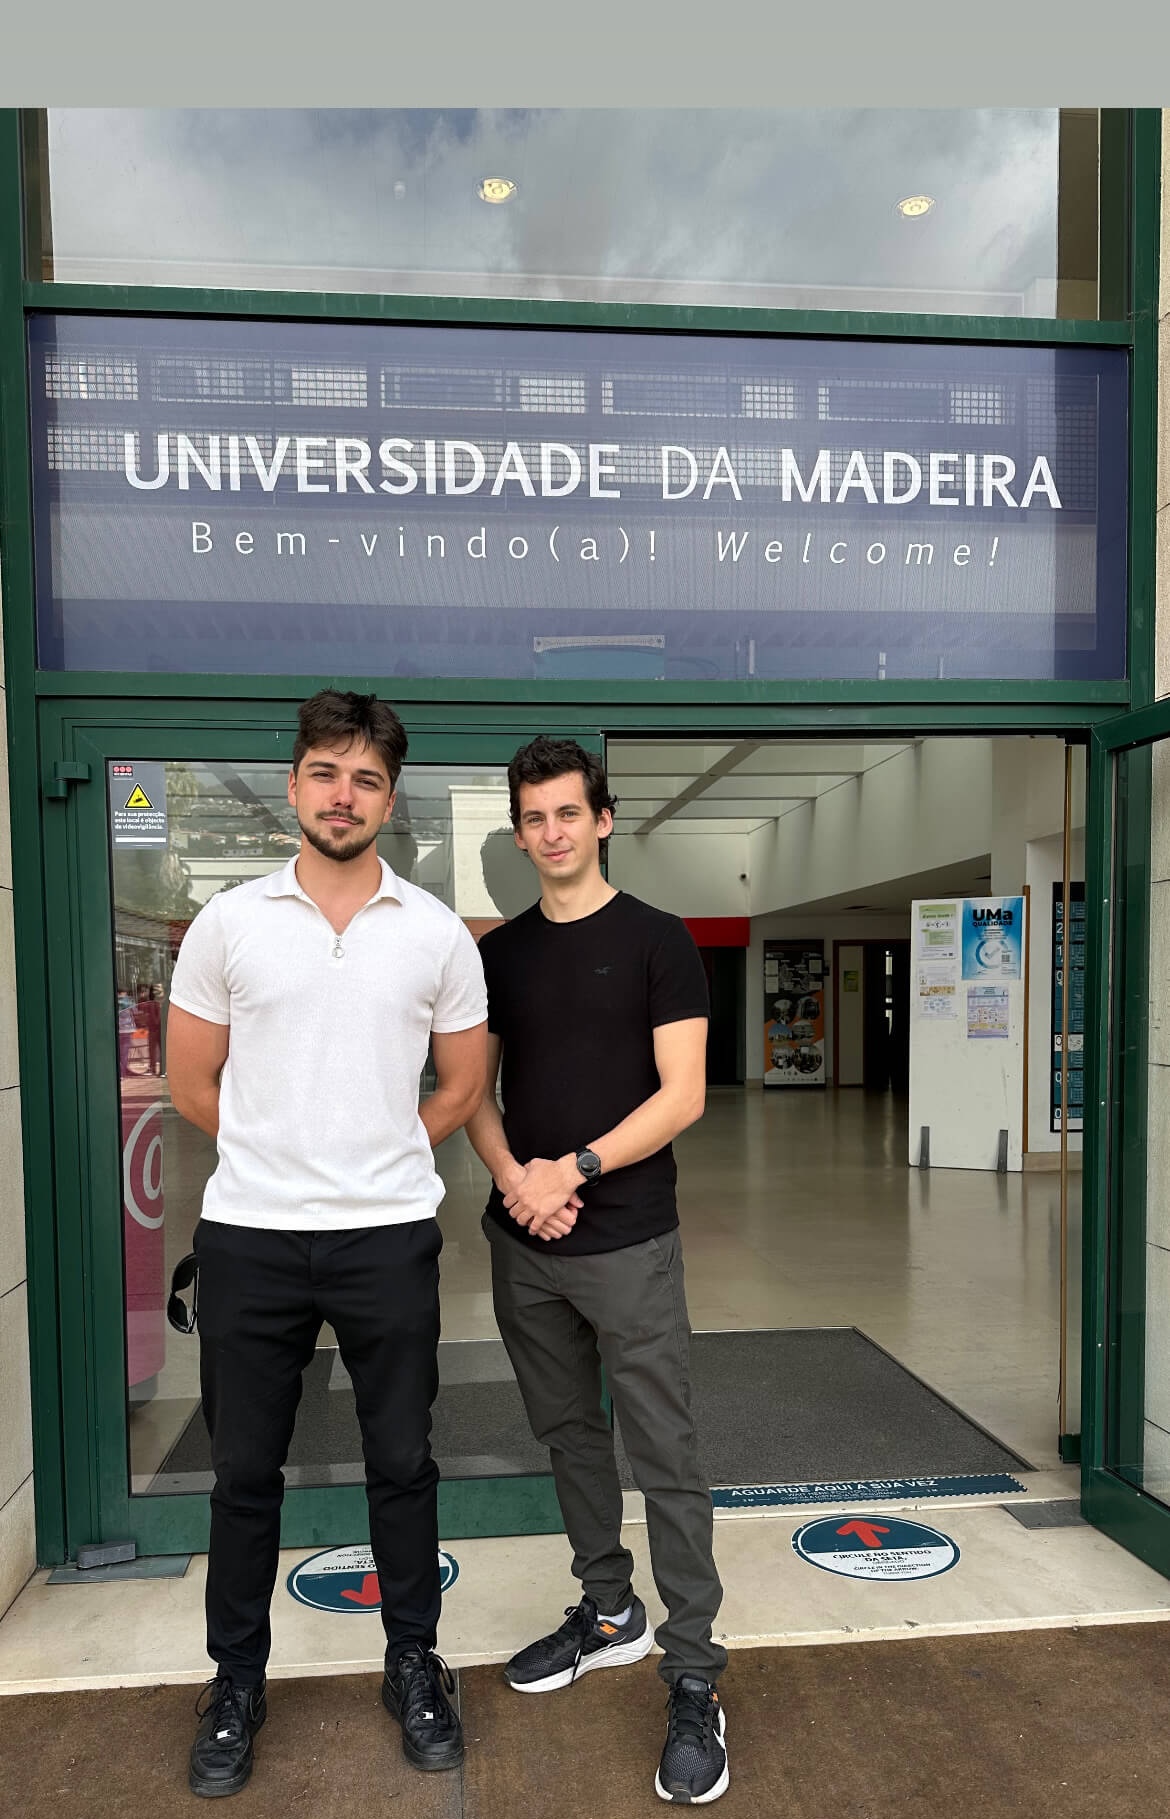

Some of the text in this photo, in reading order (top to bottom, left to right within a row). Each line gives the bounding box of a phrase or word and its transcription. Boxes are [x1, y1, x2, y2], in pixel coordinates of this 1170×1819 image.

[123, 432, 1062, 509] UNIVERSIDADE DA MADEIRA
[191, 521, 1000, 567] Bem-vindo(a)! Welcome!
[1055, 901, 1064, 914] 3
[972, 908, 1013, 921] UMa
[972, 920, 1013, 928] QUALIDADE
[1056, 922, 1064, 934] 2
[731, 1486, 810, 1496] AGUARDE
[814, 1484, 853, 1492] AQUI
[832, 1552, 872, 1560] CIRCULE
